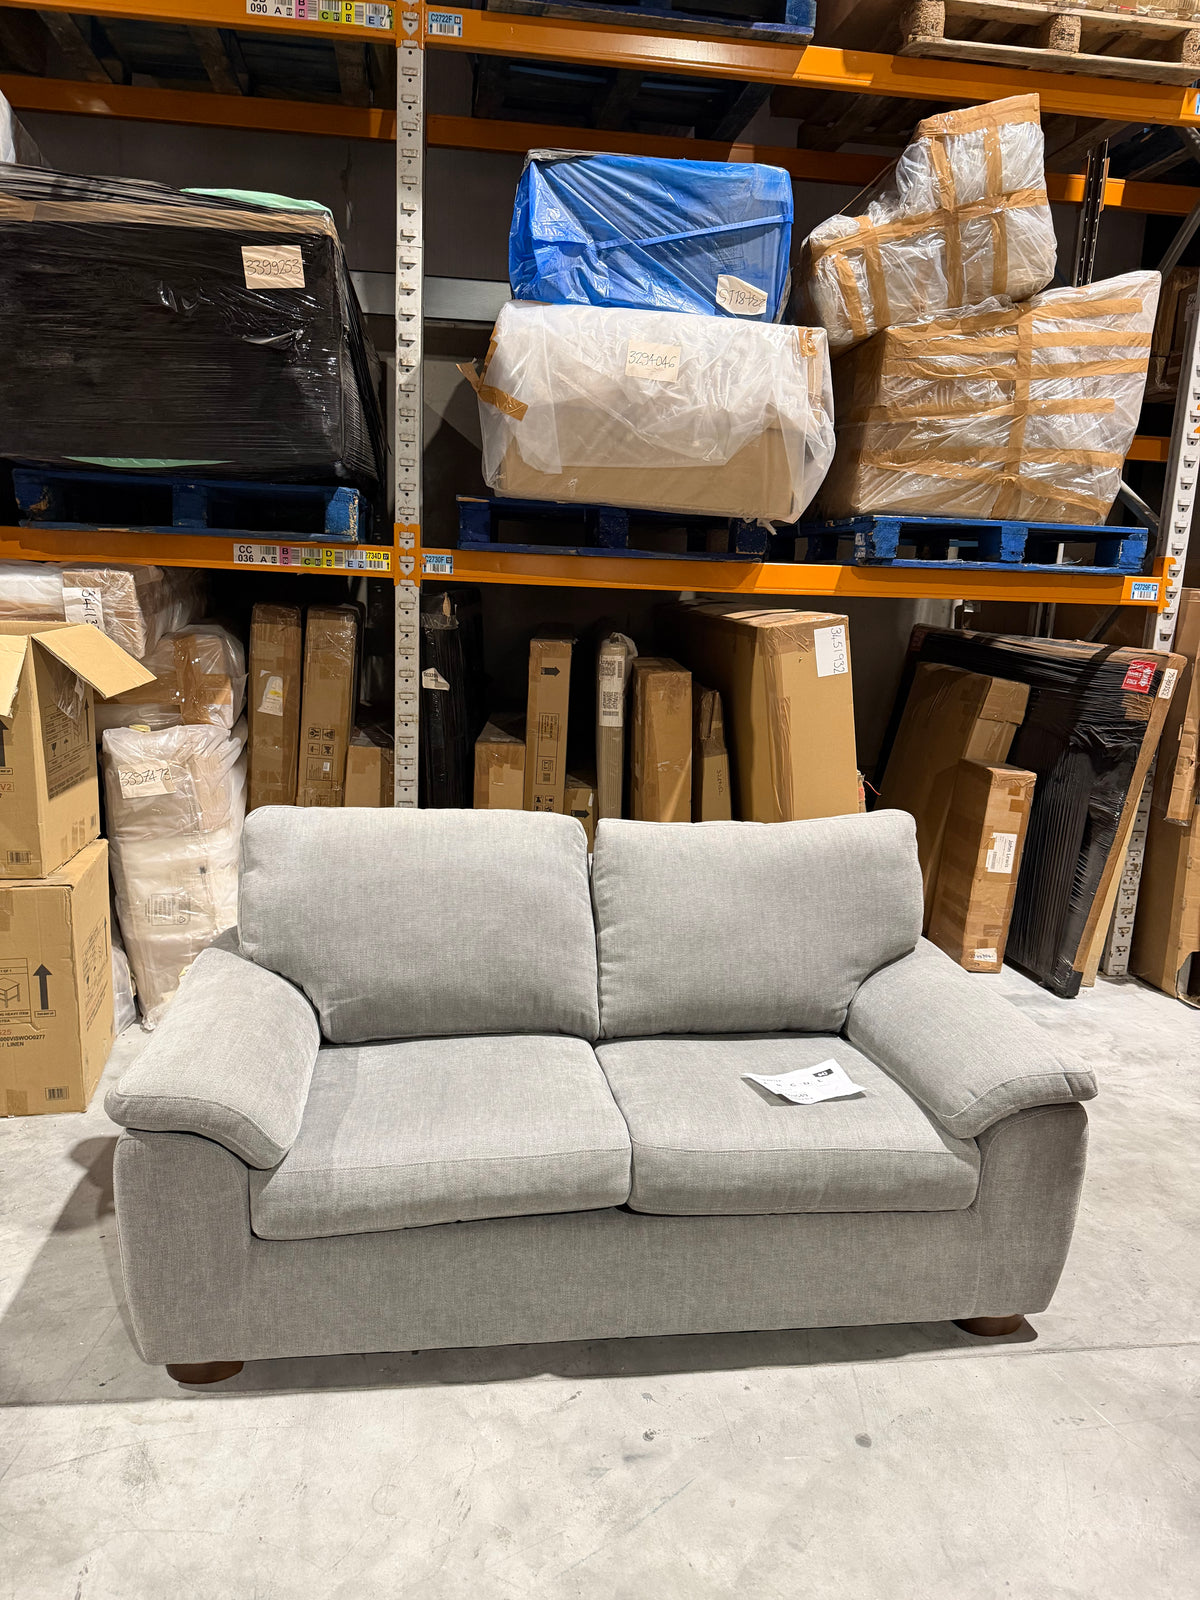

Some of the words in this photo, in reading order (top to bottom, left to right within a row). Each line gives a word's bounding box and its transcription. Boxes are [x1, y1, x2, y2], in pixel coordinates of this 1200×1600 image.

[250, 2, 268, 13] 090
[274, 6, 282, 15] A
[345, 2, 353, 11] D
[321, 11, 329, 20] C
[368, 16, 375, 25] E
[238, 544, 253, 554] CC
[281, 547, 289, 555] B
[237, 554, 254, 563] 036
[325, 550, 333, 558] D
[303, 558, 311, 566] C
[347, 560, 354, 568] E
